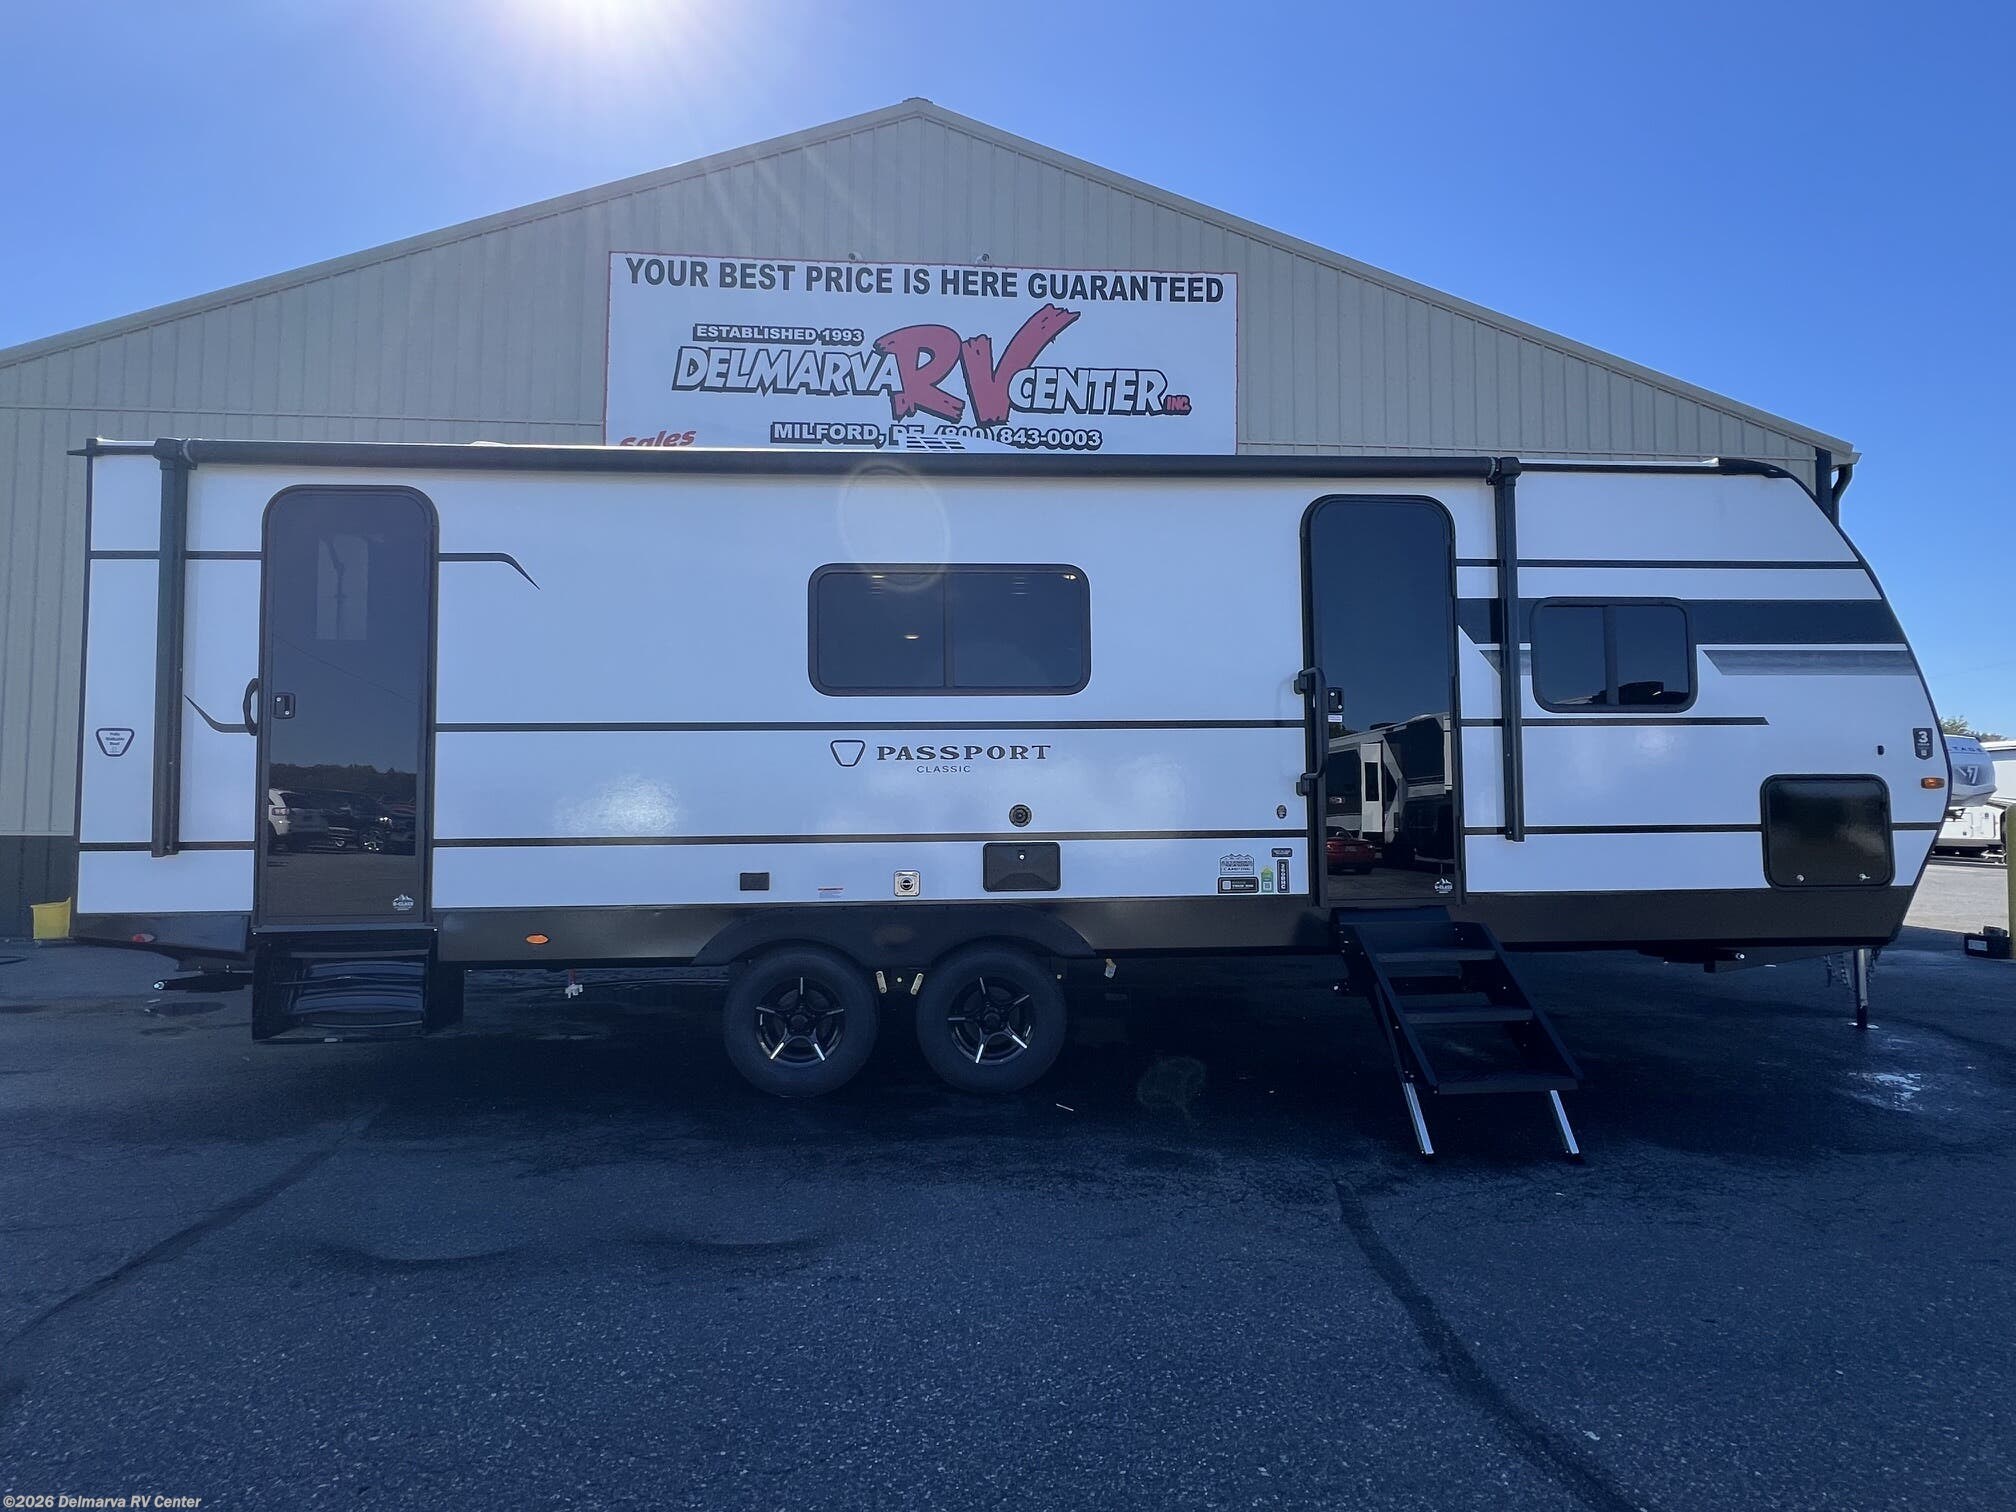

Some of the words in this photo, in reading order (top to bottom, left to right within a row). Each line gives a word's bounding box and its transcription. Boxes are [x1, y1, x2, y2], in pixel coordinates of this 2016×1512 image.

[625, 257, 709, 288] YOUR
[719, 261, 796, 291] BEST
[805, 265, 893, 294] PRICE
[903, 267, 930, 295] IS
[940, 269, 1018, 298] HERE
[1027, 272, 1224, 303] GUARANTEED
[695, 324, 817, 343] ESTABLISHED
[822, 328, 863, 344] 1993
[672, 346, 904, 396] DELMARVA
[872, 303, 1081, 427] RV
[1008, 366, 1168, 415] CENTER
[772, 422, 886, 445] MILFORD,
[999, 427, 1101, 447] 843-0003
[1918, 731, 1928, 742] 3
[876, 745, 1051, 760] PASSPORT
[916, 765, 971, 773] CLASSIC
